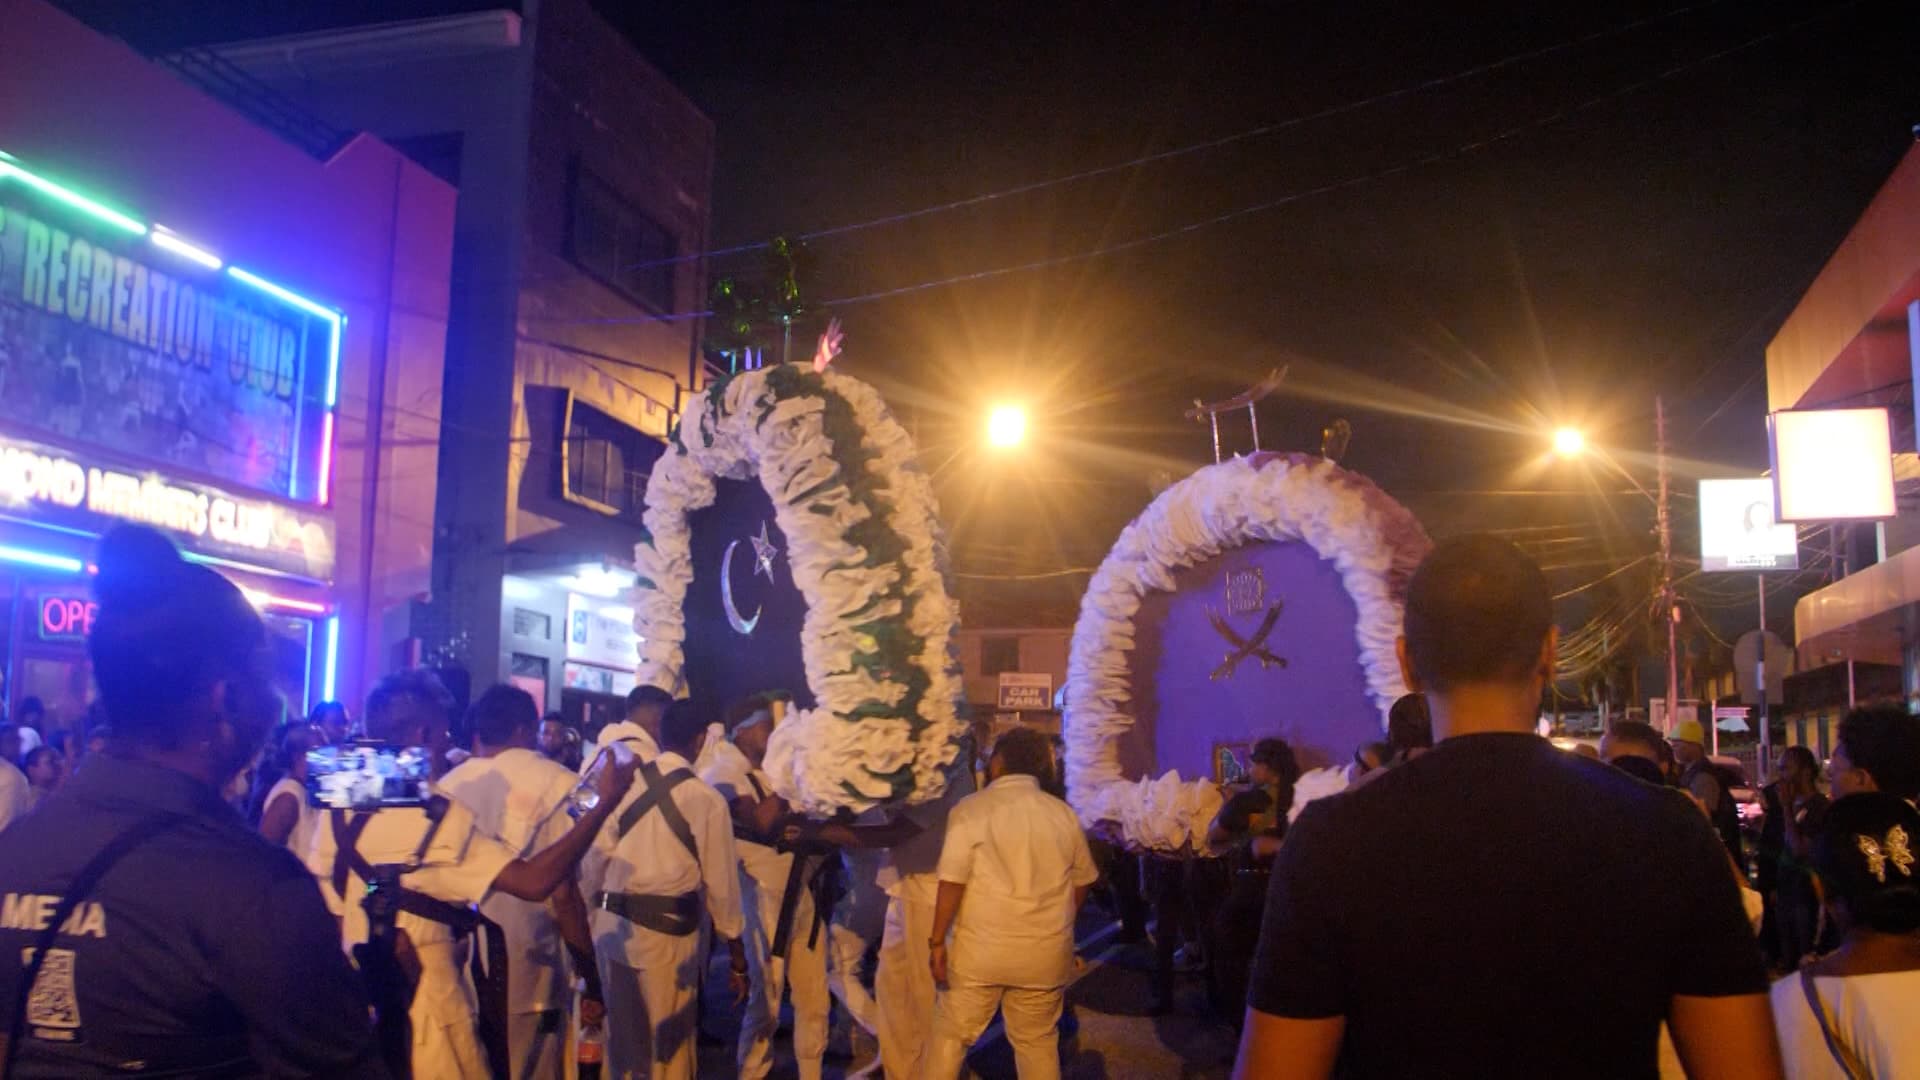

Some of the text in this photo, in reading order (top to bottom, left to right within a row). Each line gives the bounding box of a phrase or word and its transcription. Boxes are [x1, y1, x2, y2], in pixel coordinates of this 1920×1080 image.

[23, 219, 215, 371] RECREATION
[229, 308, 296, 398] CLUB
[43, 598, 97, 636] OPE
[1005, 696, 1044, 707] PARK
[1009, 687, 1040, 697] CAR
[0, 892, 107, 938] MEIA
